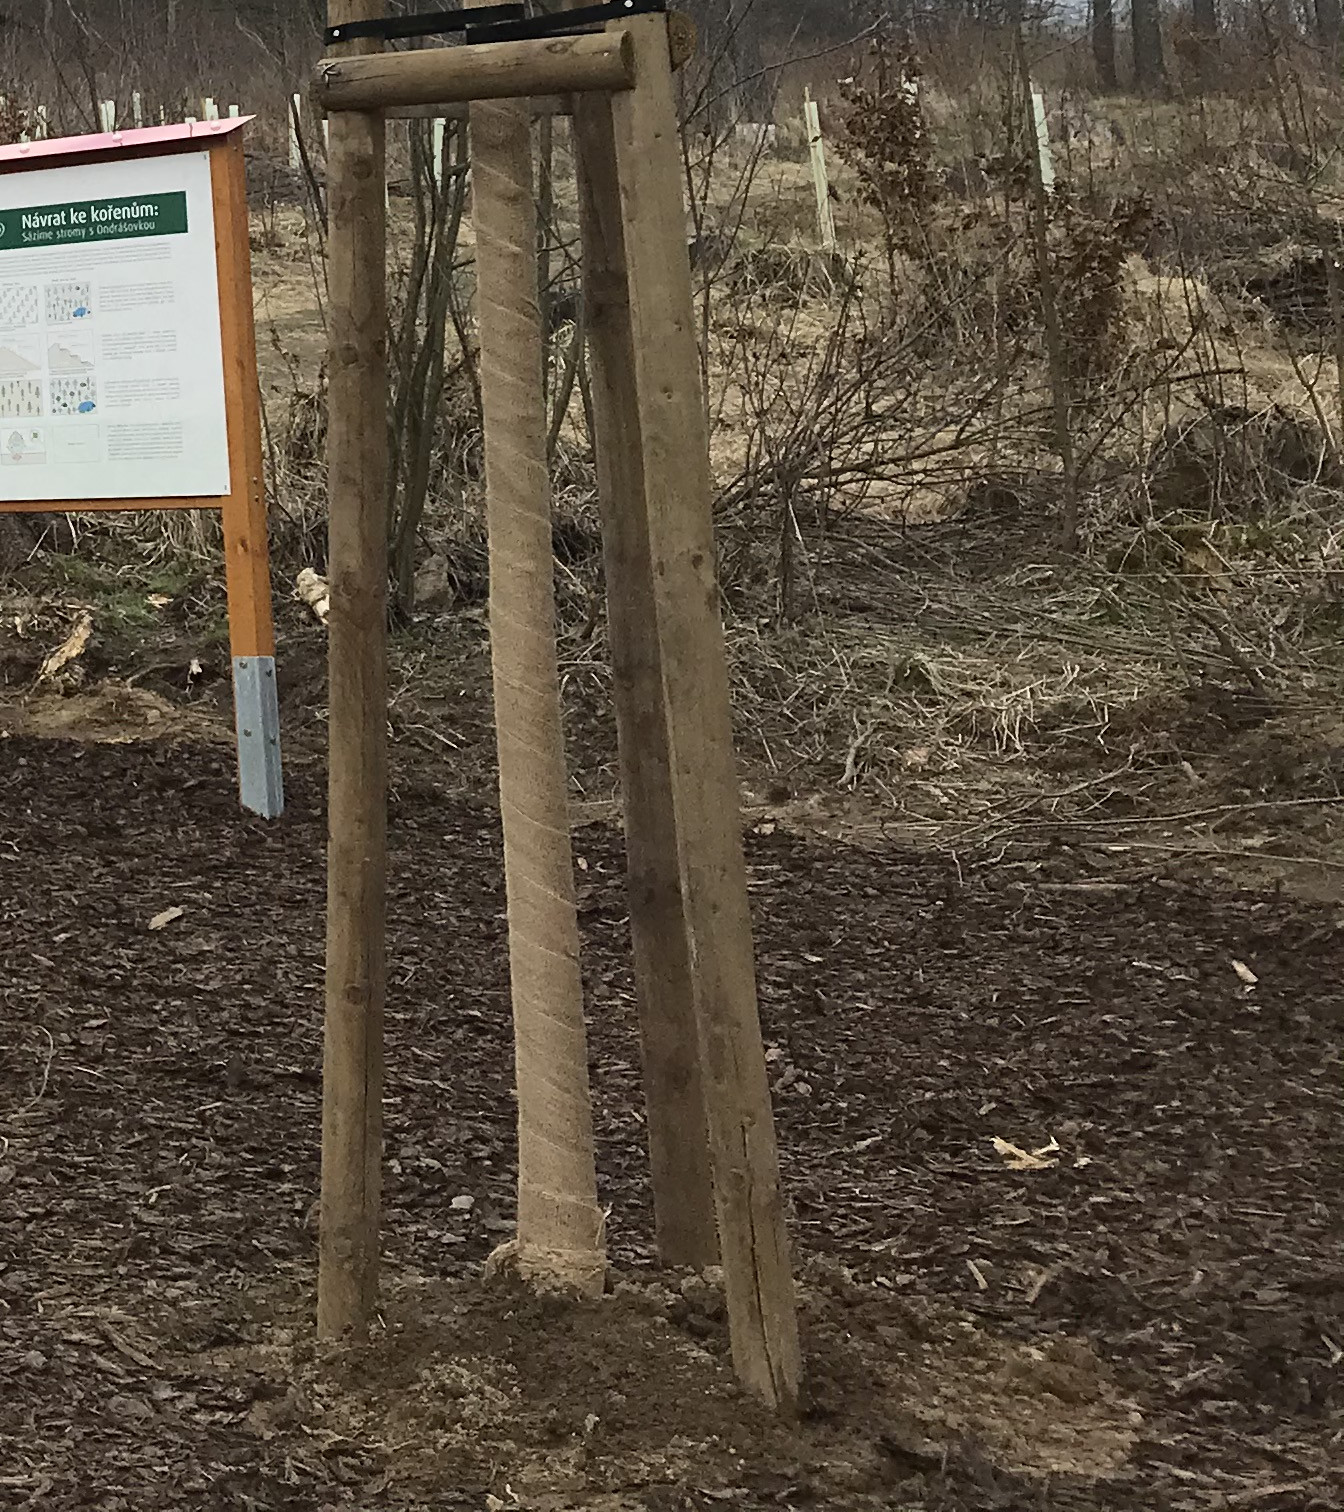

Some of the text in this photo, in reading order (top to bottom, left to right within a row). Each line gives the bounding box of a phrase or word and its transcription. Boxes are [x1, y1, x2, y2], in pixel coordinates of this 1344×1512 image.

[21, 202, 158, 229] Návrat ke kořenům:
[56, 228, 86, 239] stromy
[88, 227, 94, 236] s
[96, 220, 155, 235] Ondrášovkou
